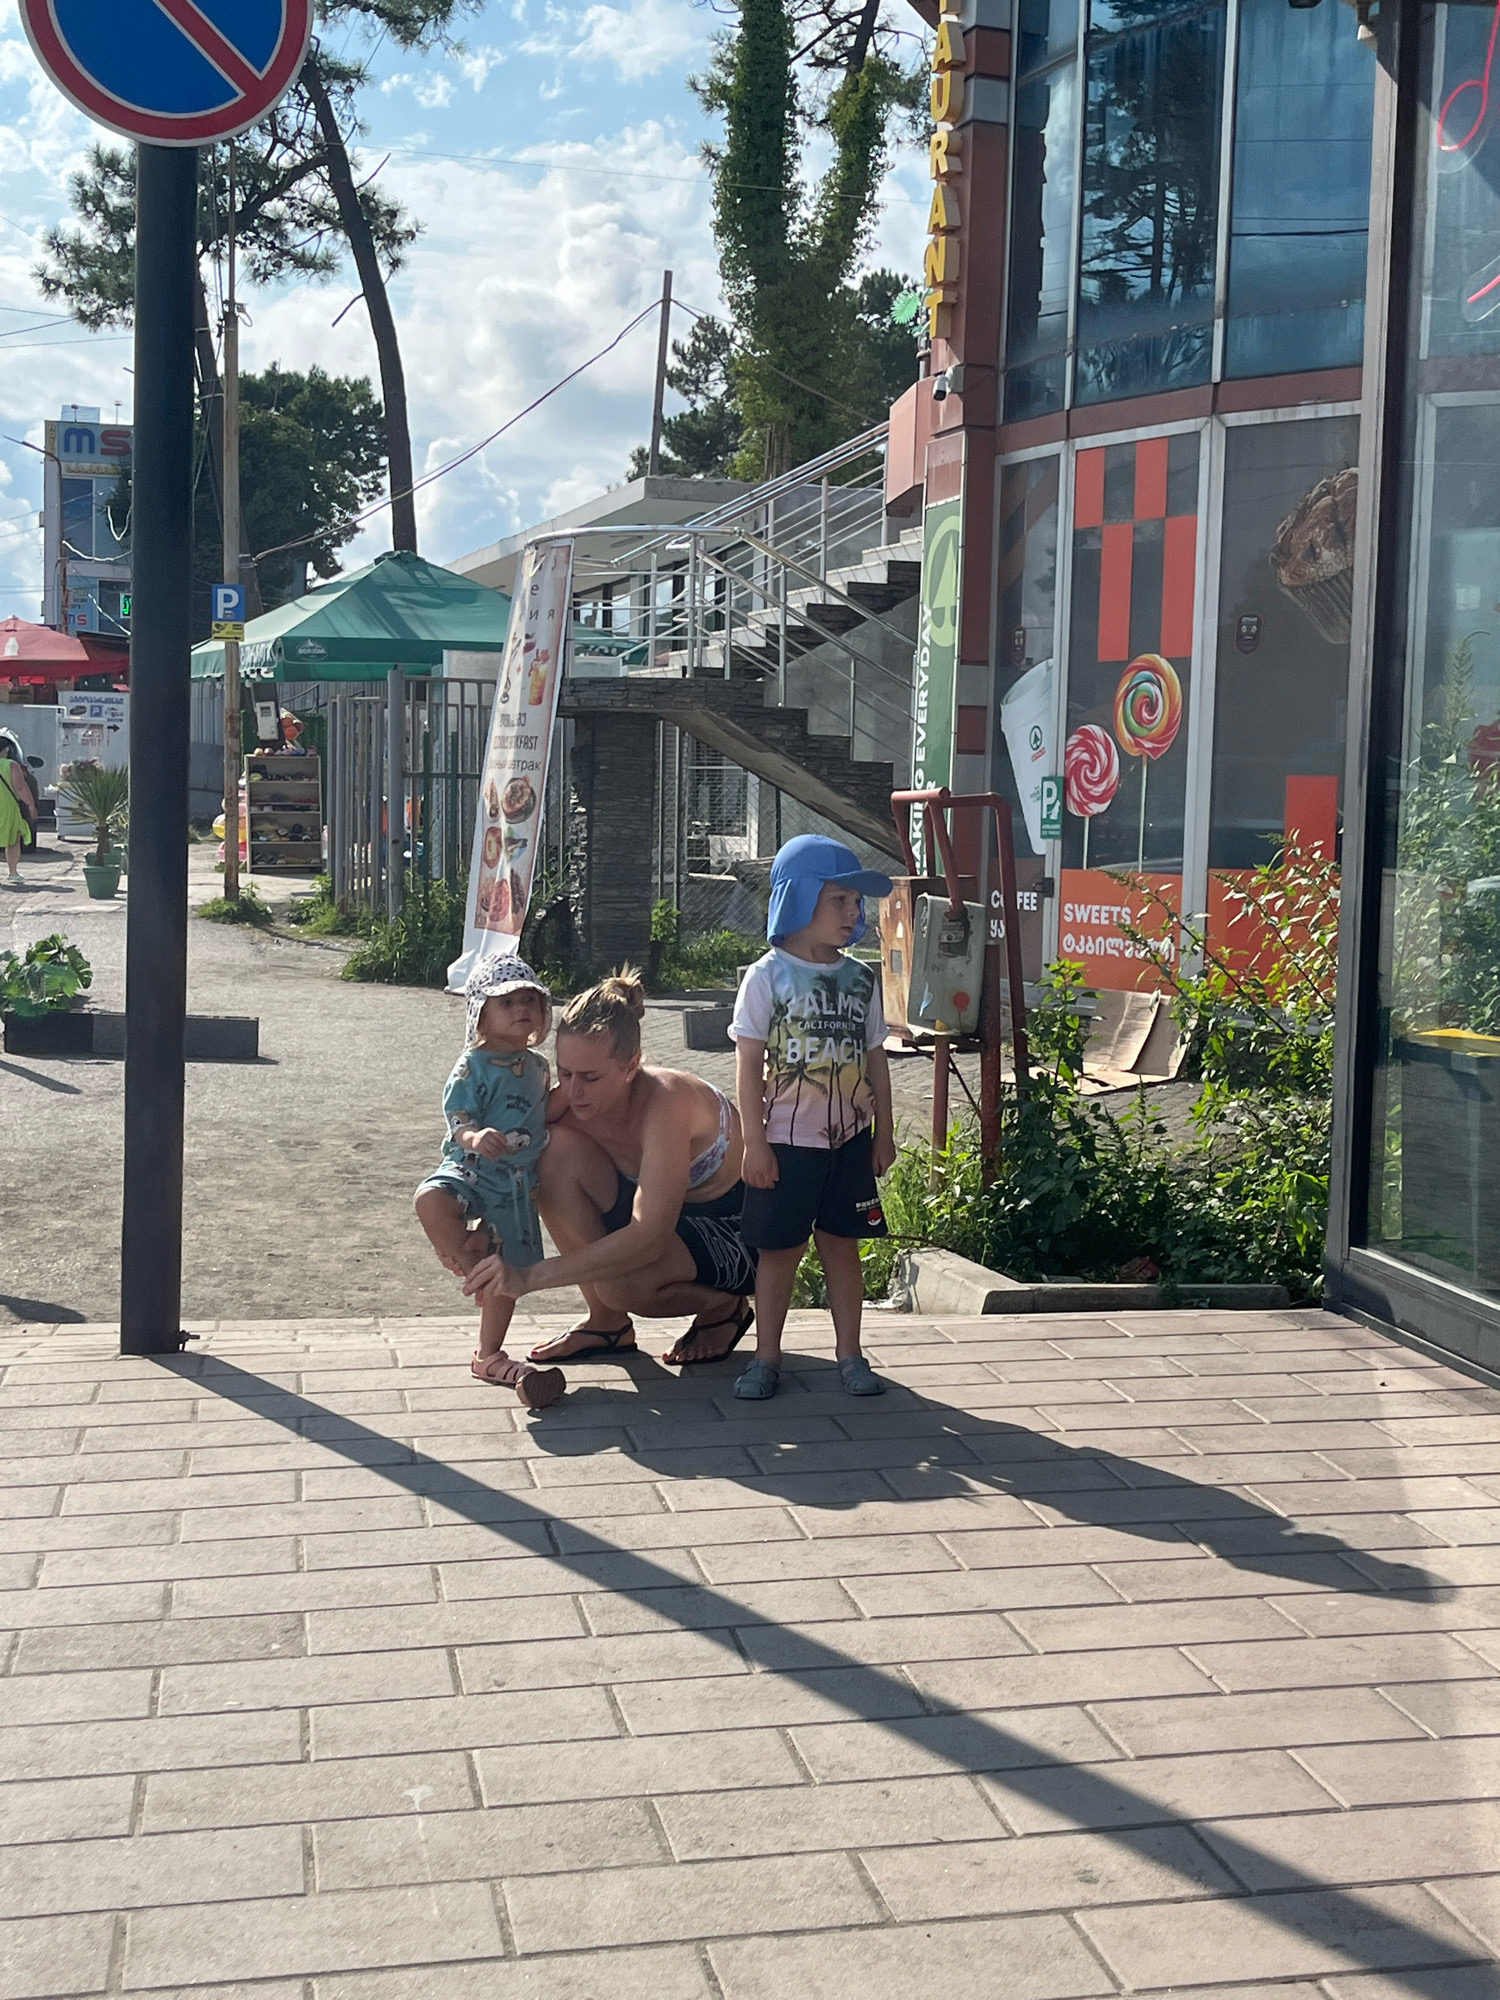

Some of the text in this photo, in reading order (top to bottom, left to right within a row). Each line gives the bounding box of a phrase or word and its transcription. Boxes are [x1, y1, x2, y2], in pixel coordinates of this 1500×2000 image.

[926, 0, 956, 339] AURANT
[217, 588, 239, 619] P
[916, 603, 933, 762] EVERYDAY
[1042, 780, 1058, 819] P
[1063, 903, 1132, 925] SWEETS
[786, 990, 866, 1024] PALMS
[786, 1036, 864, 1065] BEACH
